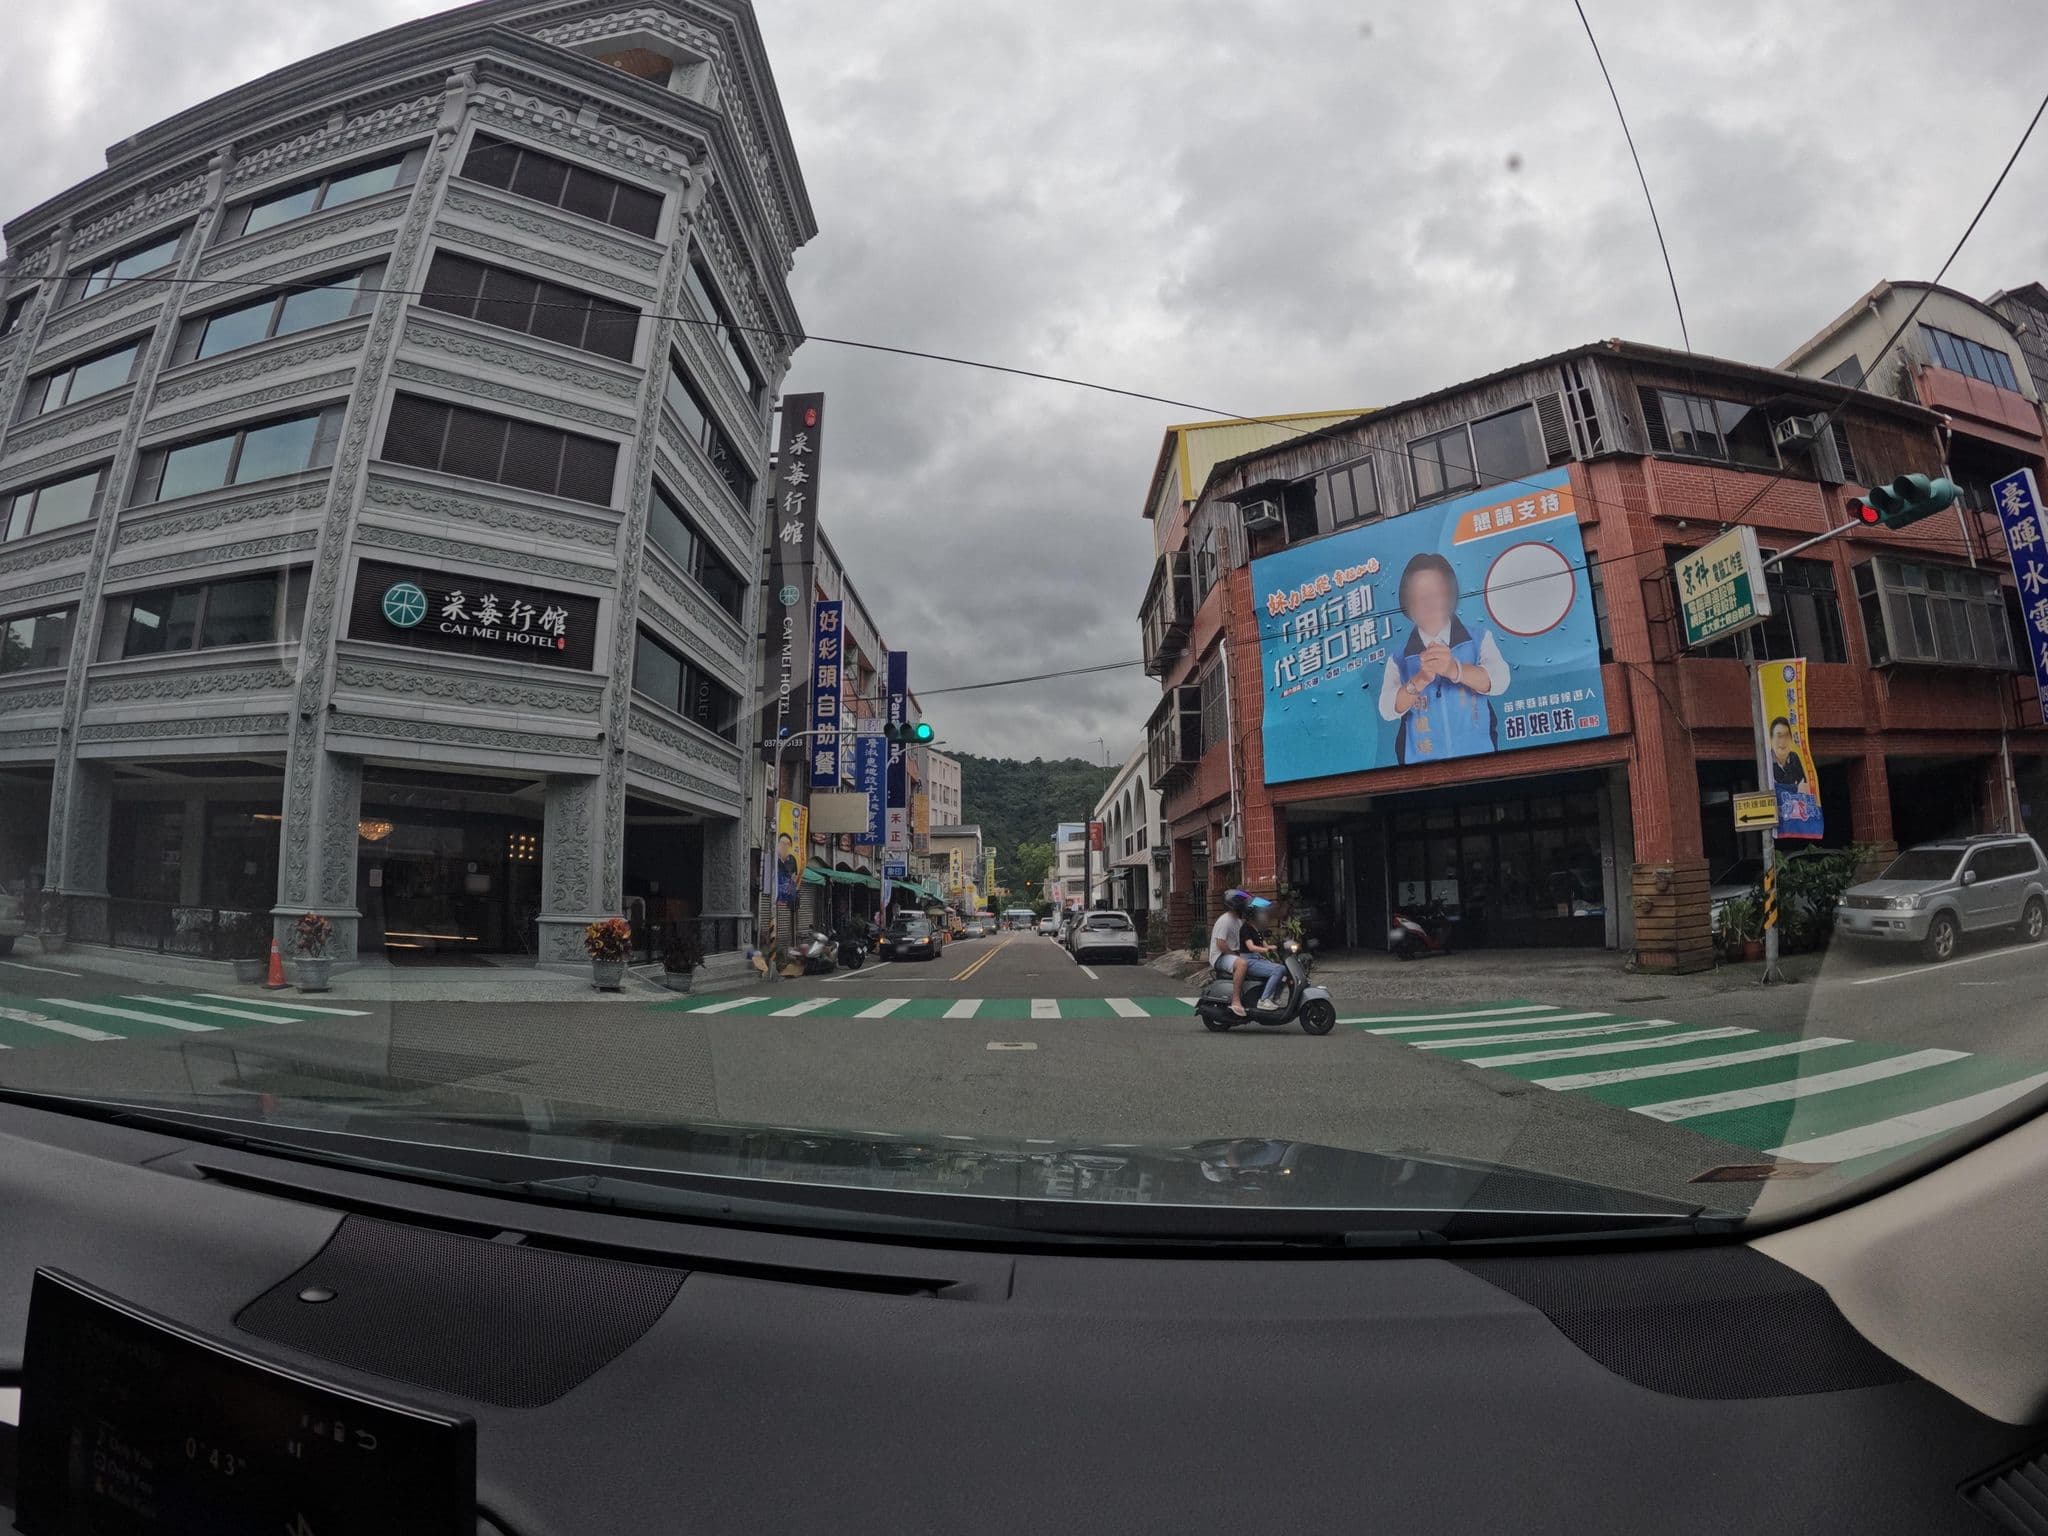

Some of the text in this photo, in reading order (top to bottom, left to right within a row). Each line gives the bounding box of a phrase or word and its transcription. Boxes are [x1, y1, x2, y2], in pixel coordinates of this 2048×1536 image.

[1472, 493, 1560, 533] 懇請支持
[2000, 481, 2048, 675] 豪暉水電
[440, 622, 467, 635] CAI
[472, 626, 499, 640] MEI
[506, 631, 556, 649] HOTEL
[782, 616, 793, 642] CAI
[781, 644, 793, 667] MEI
[814, 609, 840, 776] 好彩頭自助餐
[1503, 687, 1597, 713] 苗栗縣議員候選人
[890, 693, 903, 765] Pananic
[1505, 707, 1576, 740] 胡娘妹
[890, 813, 901, 842] 禾正
